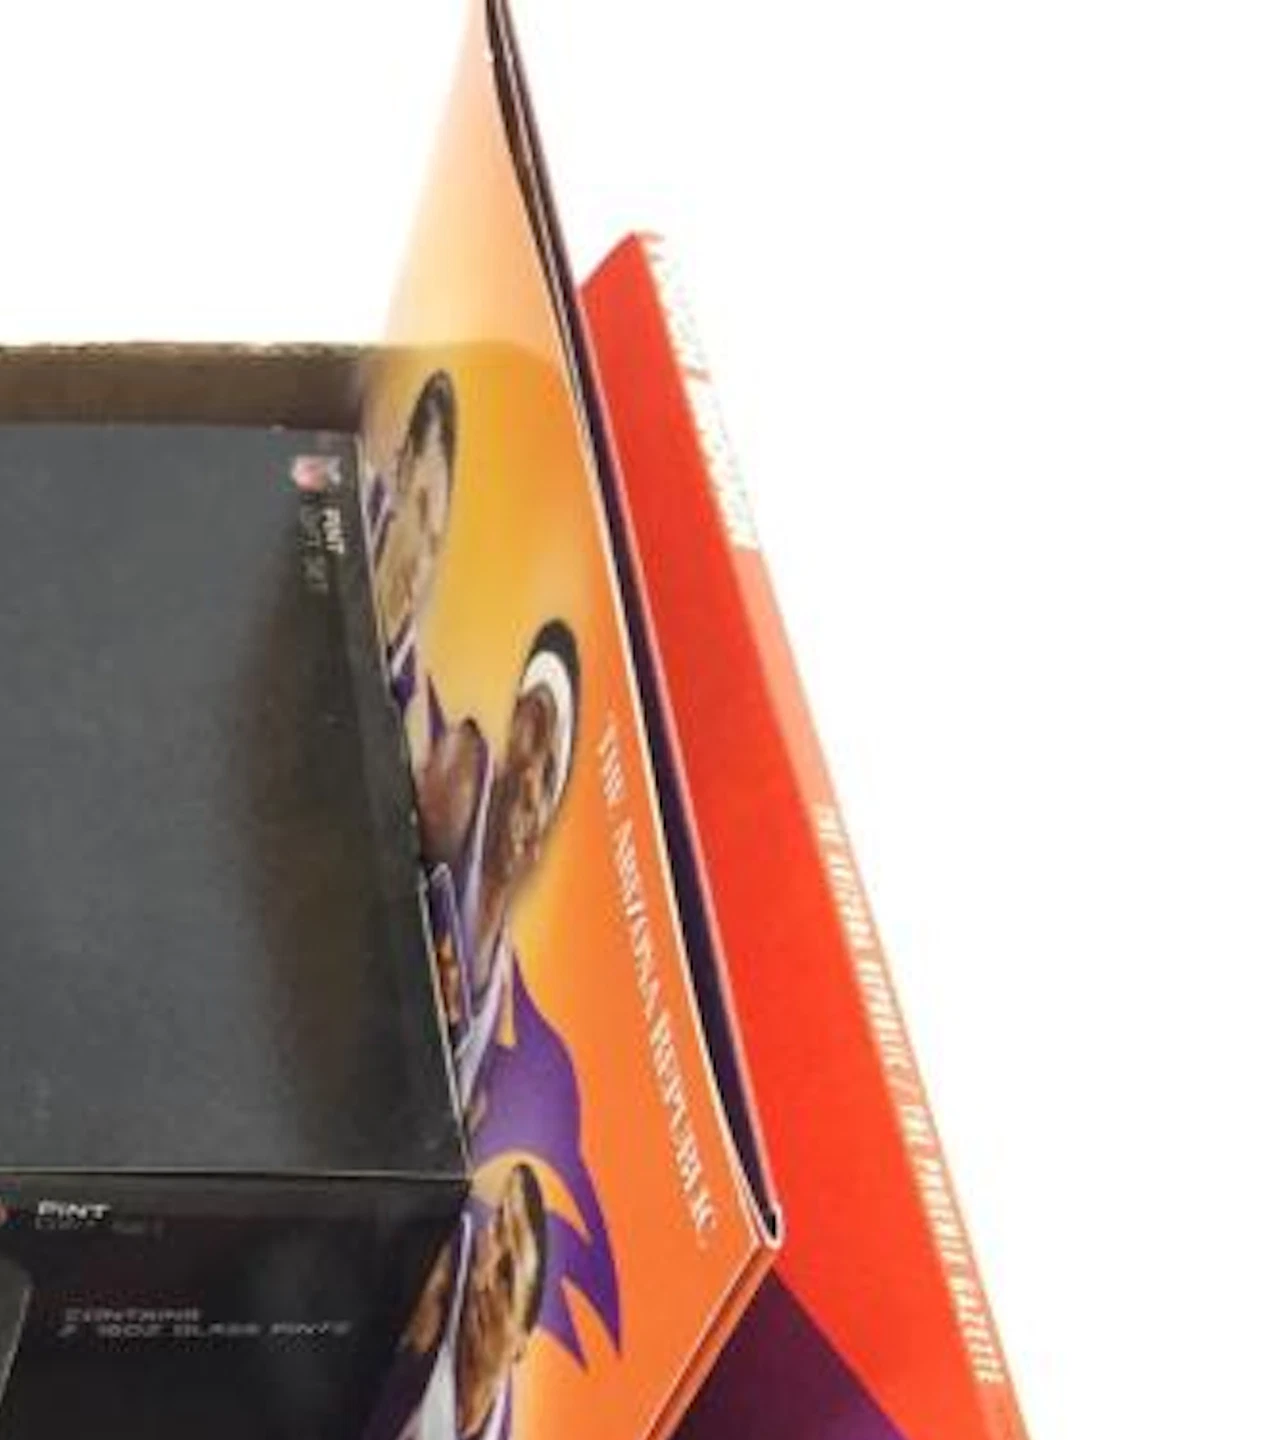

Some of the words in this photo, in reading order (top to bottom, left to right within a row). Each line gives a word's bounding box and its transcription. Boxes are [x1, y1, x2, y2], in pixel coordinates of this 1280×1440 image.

[37, 1199, 112, 1220] PINT
[598, 722, 625, 808] THE
[613, 818, 661, 1021] ARIZONA
[649, 1011, 717, 1233] REPUBLIC
[826, 851, 876, 951] ARIZONA
[854, 957, 912, 1069] REPUBLIC
[912, 1156, 971, 1262] PHOENIX
[947, 1265, 1007, 1384] GAZETTE
